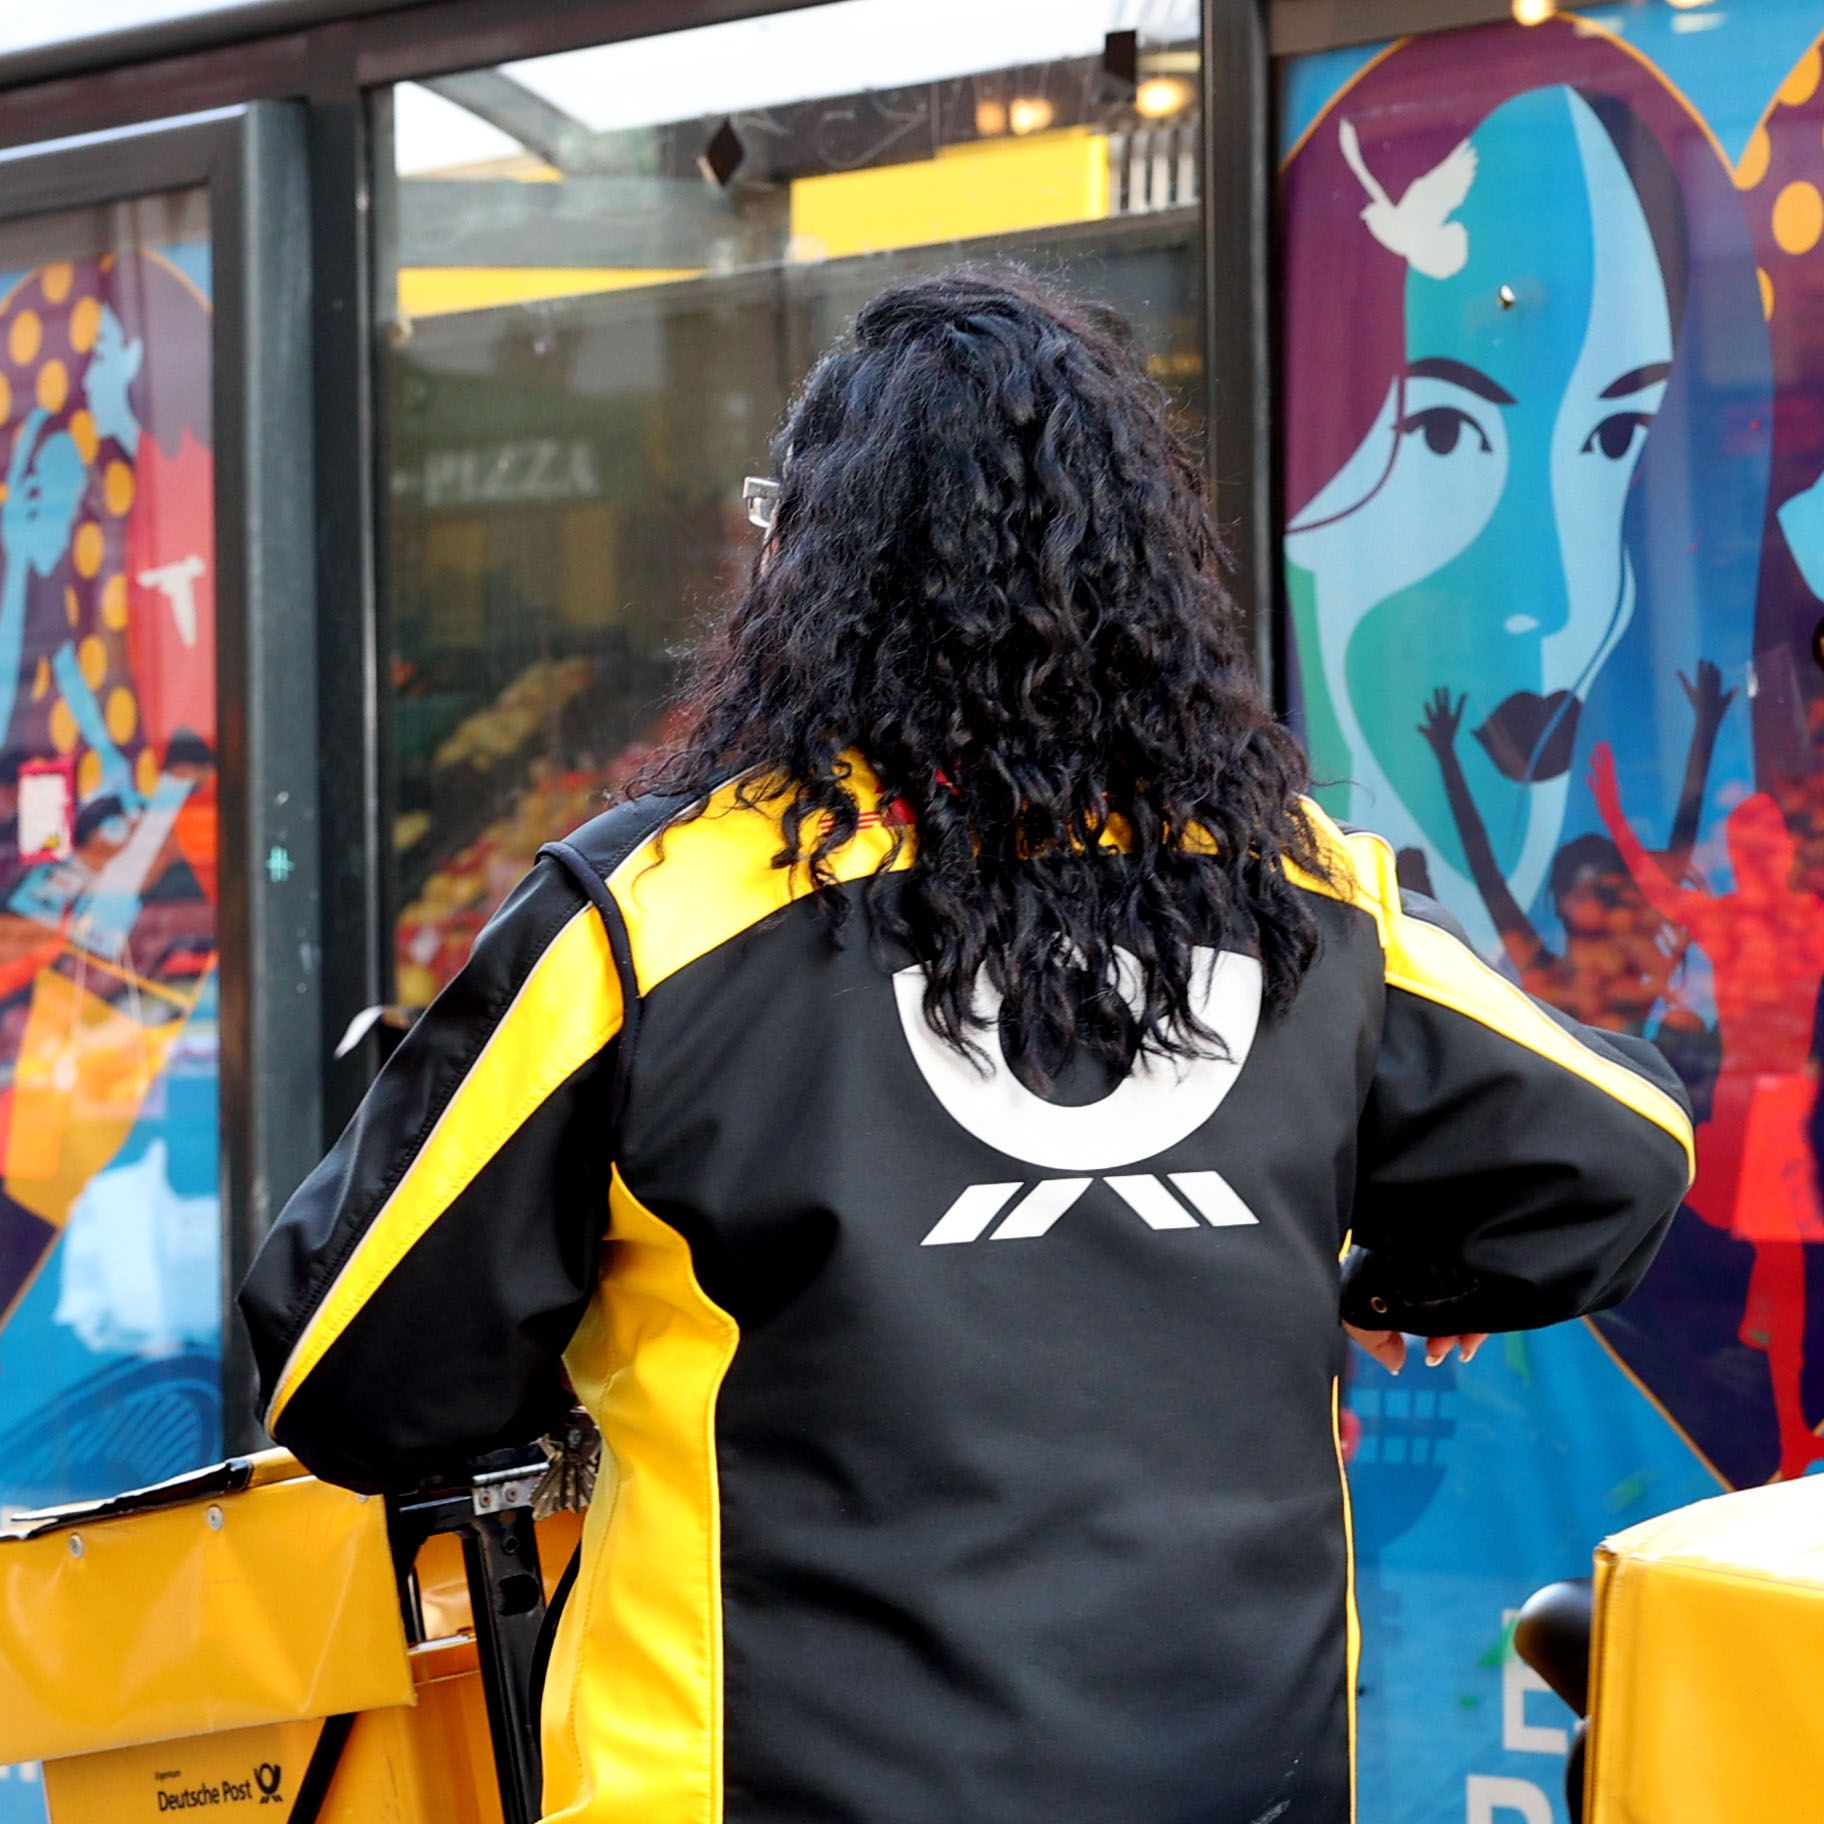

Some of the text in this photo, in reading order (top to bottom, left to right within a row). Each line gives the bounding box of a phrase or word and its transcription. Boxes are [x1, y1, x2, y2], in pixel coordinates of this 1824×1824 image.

[424, 439, 599, 506] PIZZA
[157, 1779, 253, 1812] Deutsche Post
